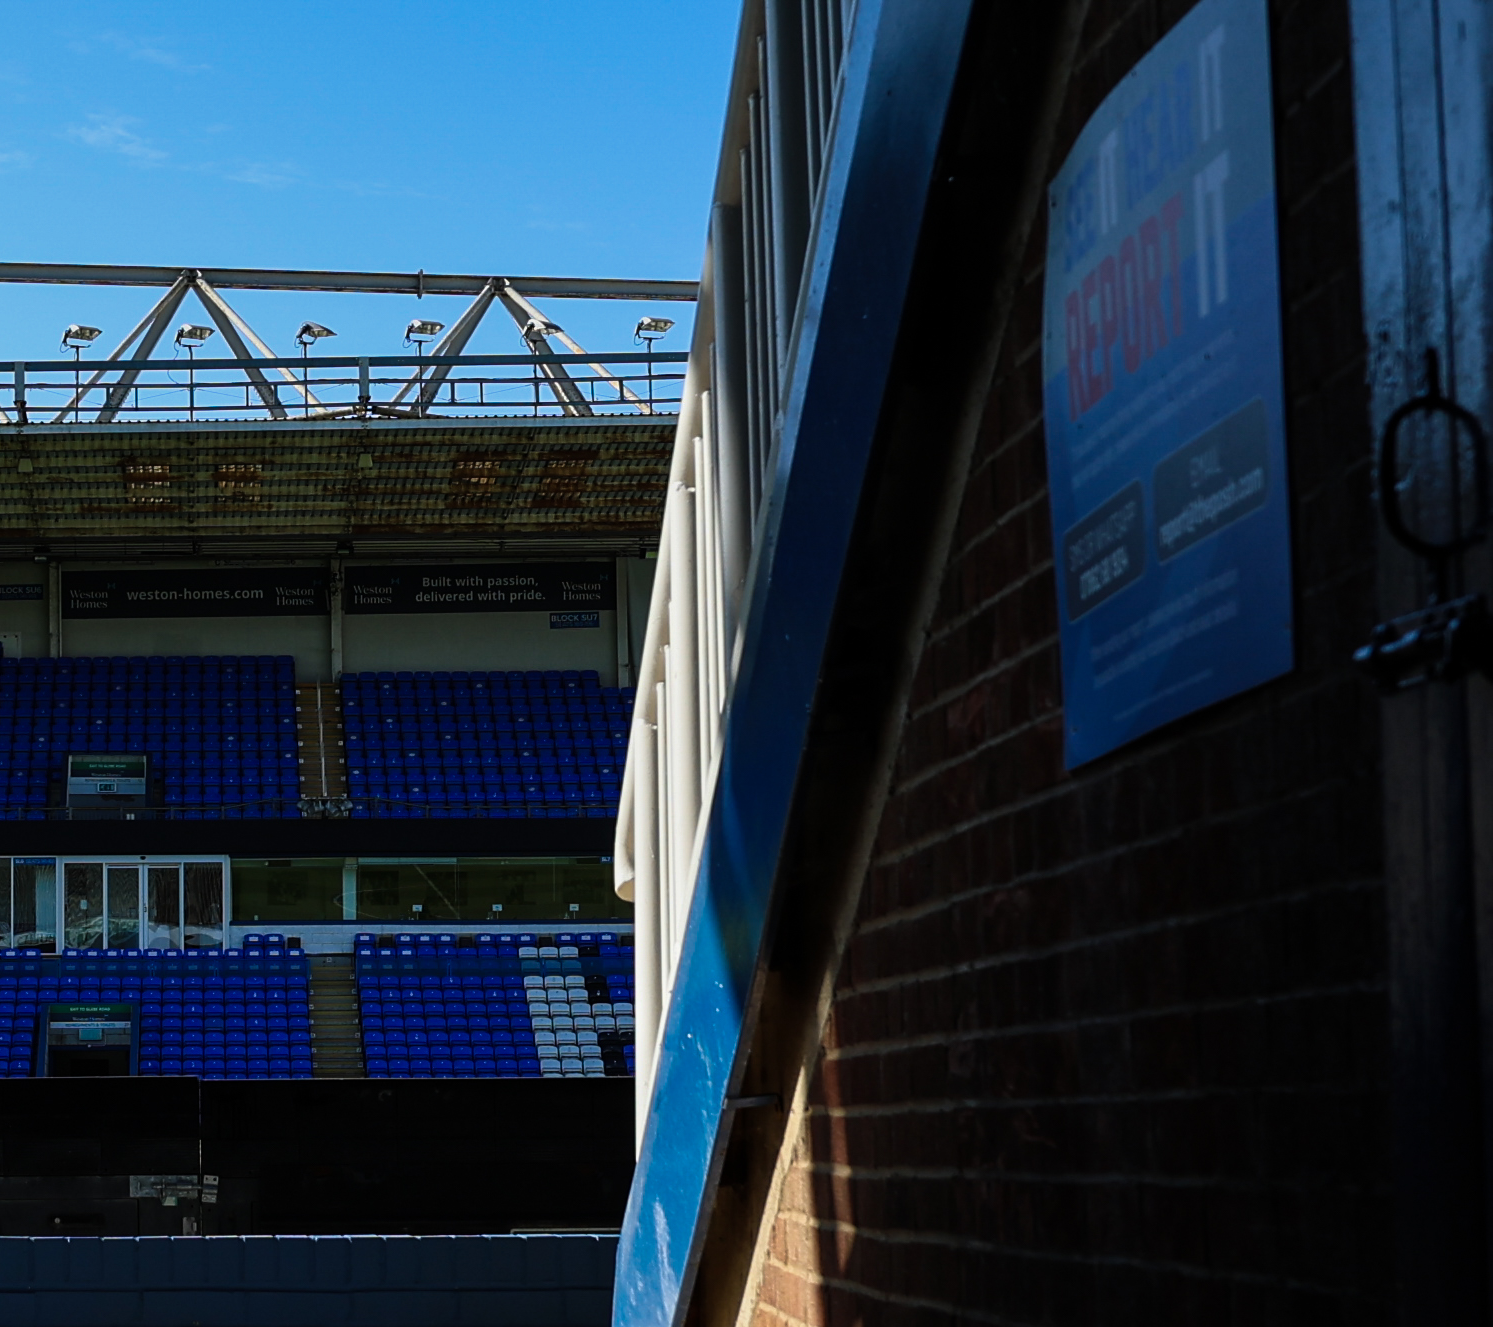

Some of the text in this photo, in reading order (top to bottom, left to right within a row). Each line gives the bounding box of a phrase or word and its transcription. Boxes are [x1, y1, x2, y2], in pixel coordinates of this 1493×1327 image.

[1099, 127, 1119, 238] IT
[1199, 23, 1226, 144] IT
[1065, 191, 1185, 423] REPORT
[1194, 148, 1230, 320] IT
[422, 575, 539, 589] Built with passion,
[562, 580, 602, 591] Weston
[69, 589, 109, 600] Weston
[126, 587, 264, 601] weston-homes.com
[275, 586, 315, 597] Weston
[353, 584, 393, 595] Weston
[354, 594, 392, 605] Homes
[415, 590, 546, 603] delivered with pride.
[563, 590, 601, 601] Homes
[70, 599, 108, 609] Homes
[276, 596, 314, 607] Homes
[551, 614, 579, 622] BLOCK
